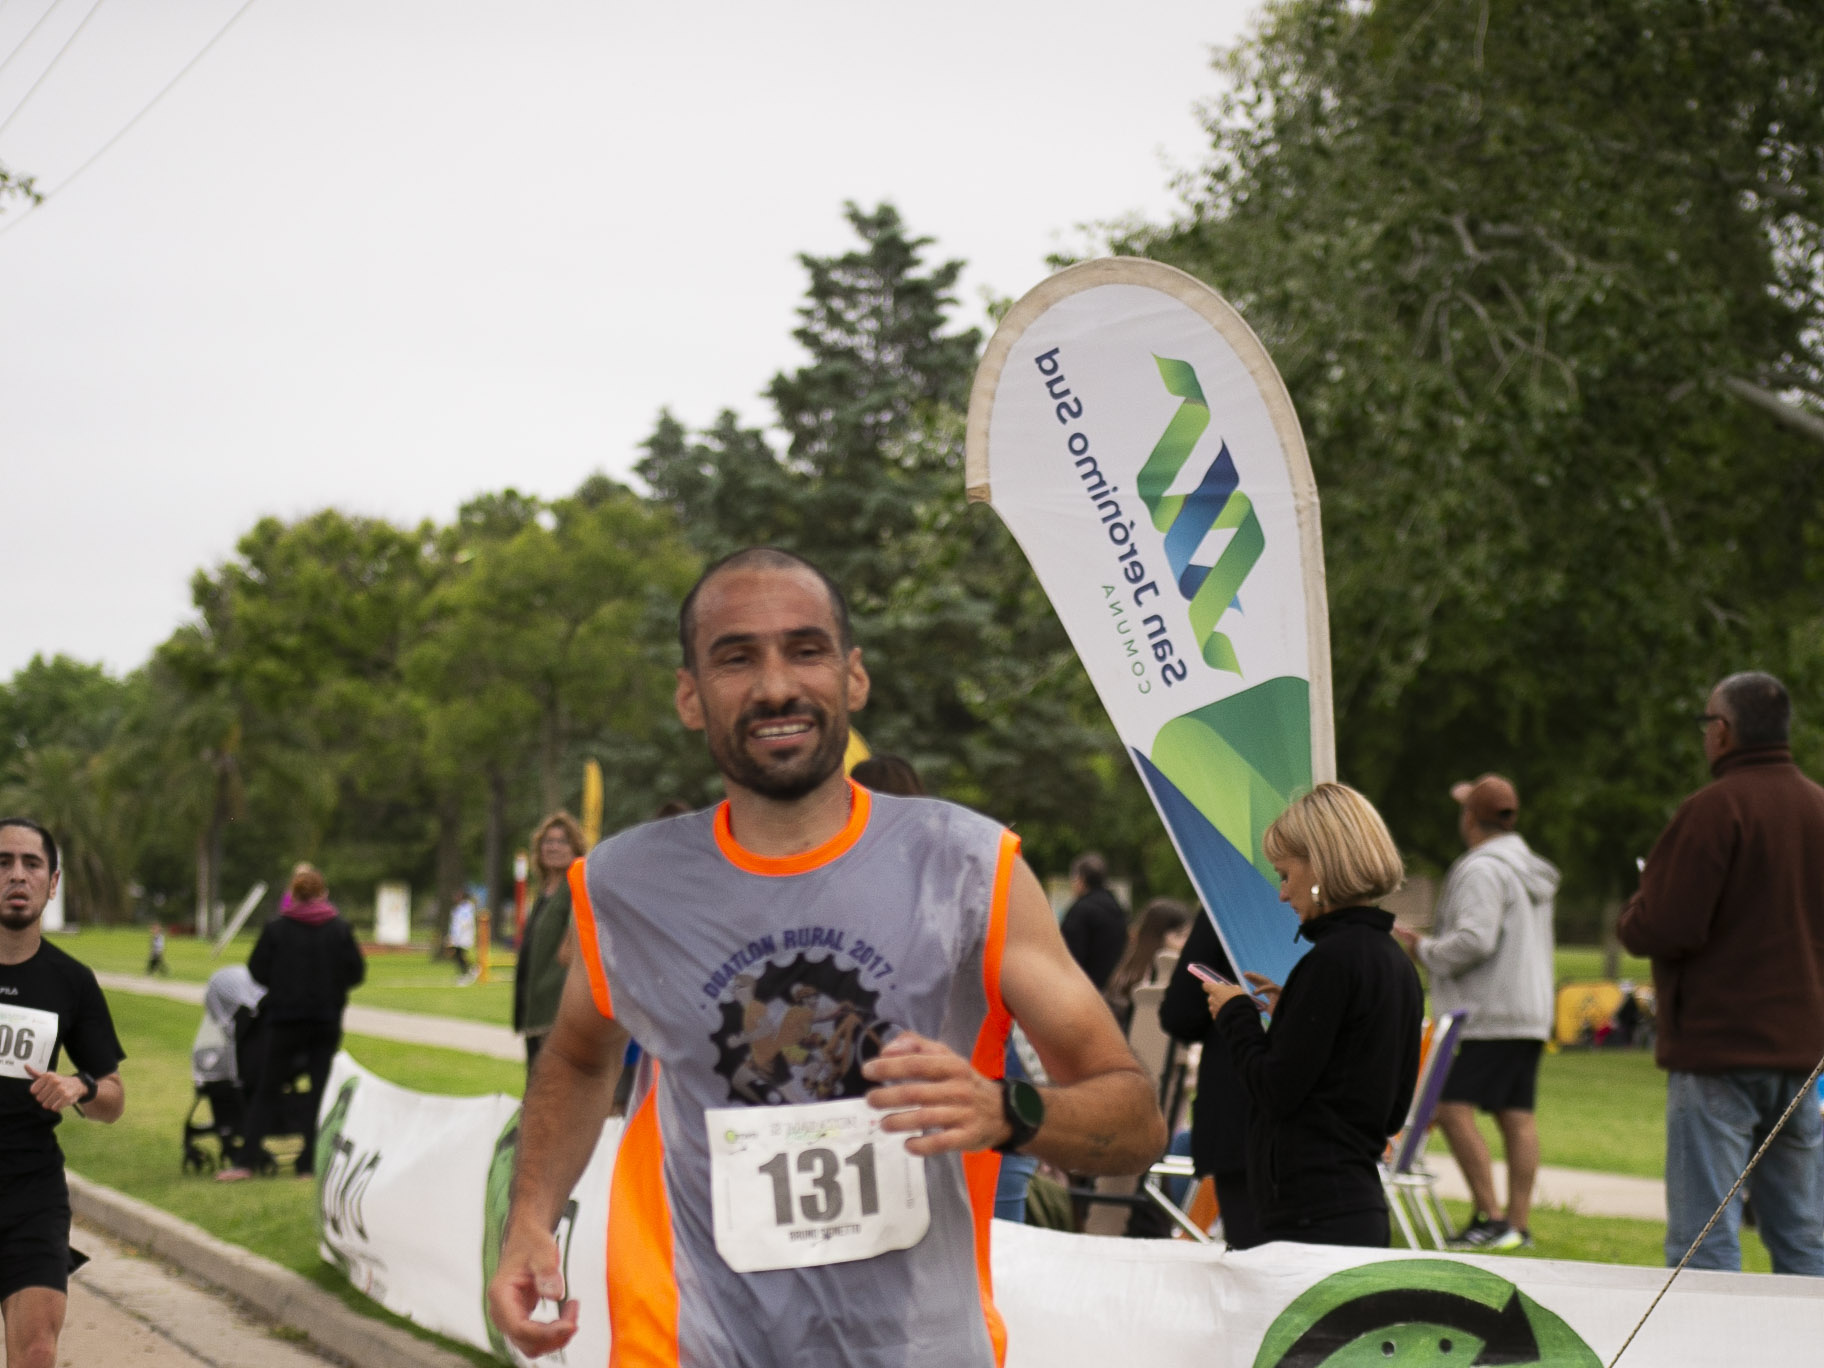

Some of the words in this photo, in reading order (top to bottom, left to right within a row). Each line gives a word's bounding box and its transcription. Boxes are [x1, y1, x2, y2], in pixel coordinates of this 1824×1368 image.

[702, 935, 776, 999] DUATLON
[783, 927, 844, 950] RURAL
[850, 939, 894, 979] 2017
[758, 1142, 880, 1226] 131
